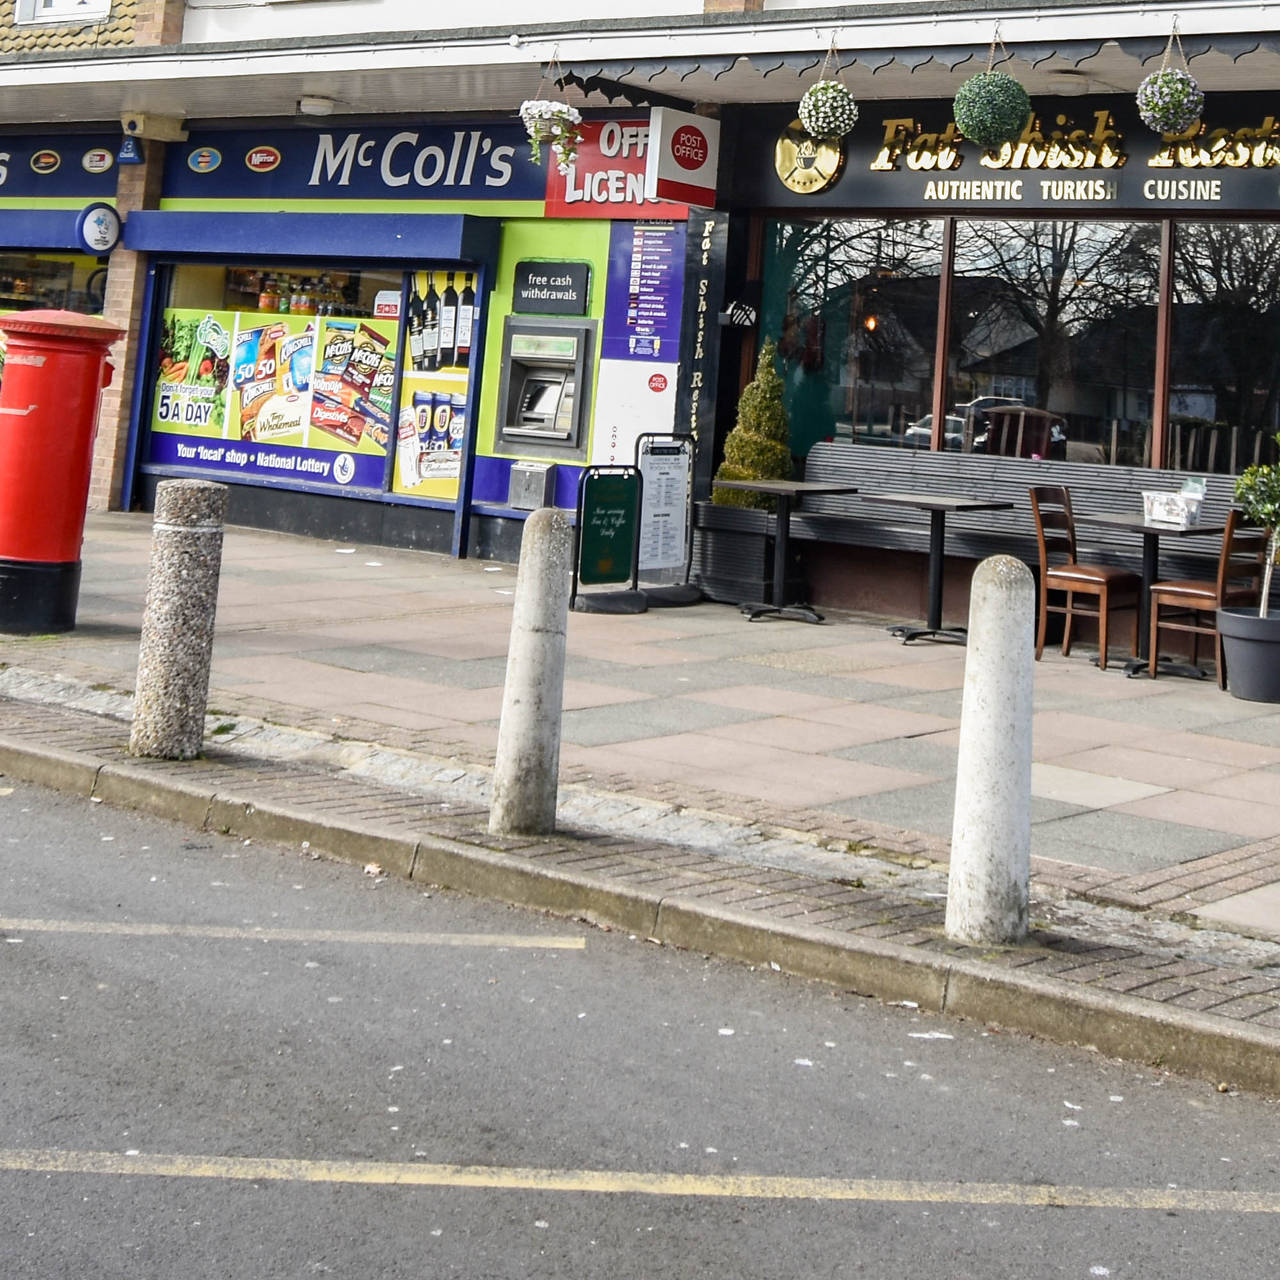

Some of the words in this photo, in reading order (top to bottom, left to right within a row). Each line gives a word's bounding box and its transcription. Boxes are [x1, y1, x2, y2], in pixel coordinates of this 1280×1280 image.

[679, 133, 702, 147] POST
[870, 118, 961, 171] Fat
[308, 131, 516, 187] McColl's
[674, 145, 704, 162] OFFICE
[564, 164, 660, 205] LICEN
[923, 179, 1022, 201] AUTHENTIC
[1040, 179, 1118, 201] TURKISH
[1143, 179, 1221, 201] CUISINE
[701, 220, 715, 266] Fat
[528, 273, 548, 284] free
[549, 274, 572, 286] cash
[521, 288, 577, 300] withdrawals
[694, 279, 708, 360] Shish
[235, 364, 255, 383] 50
[256, 359, 276, 379] 50
[162, 382, 178, 392] Don't
[179, 384, 198, 395] forget
[199, 388, 214, 397] your
[159, 395, 170, 419] 5
[171, 403, 180, 420] A
[185, 404, 211, 424] DAY
[260, 417, 301, 433] Wholemeal
[177, 444, 196, 458] Your
[225, 449, 247, 467] shop
[256, 452, 295, 469] National
[296, 457, 330, 477] Lottery
